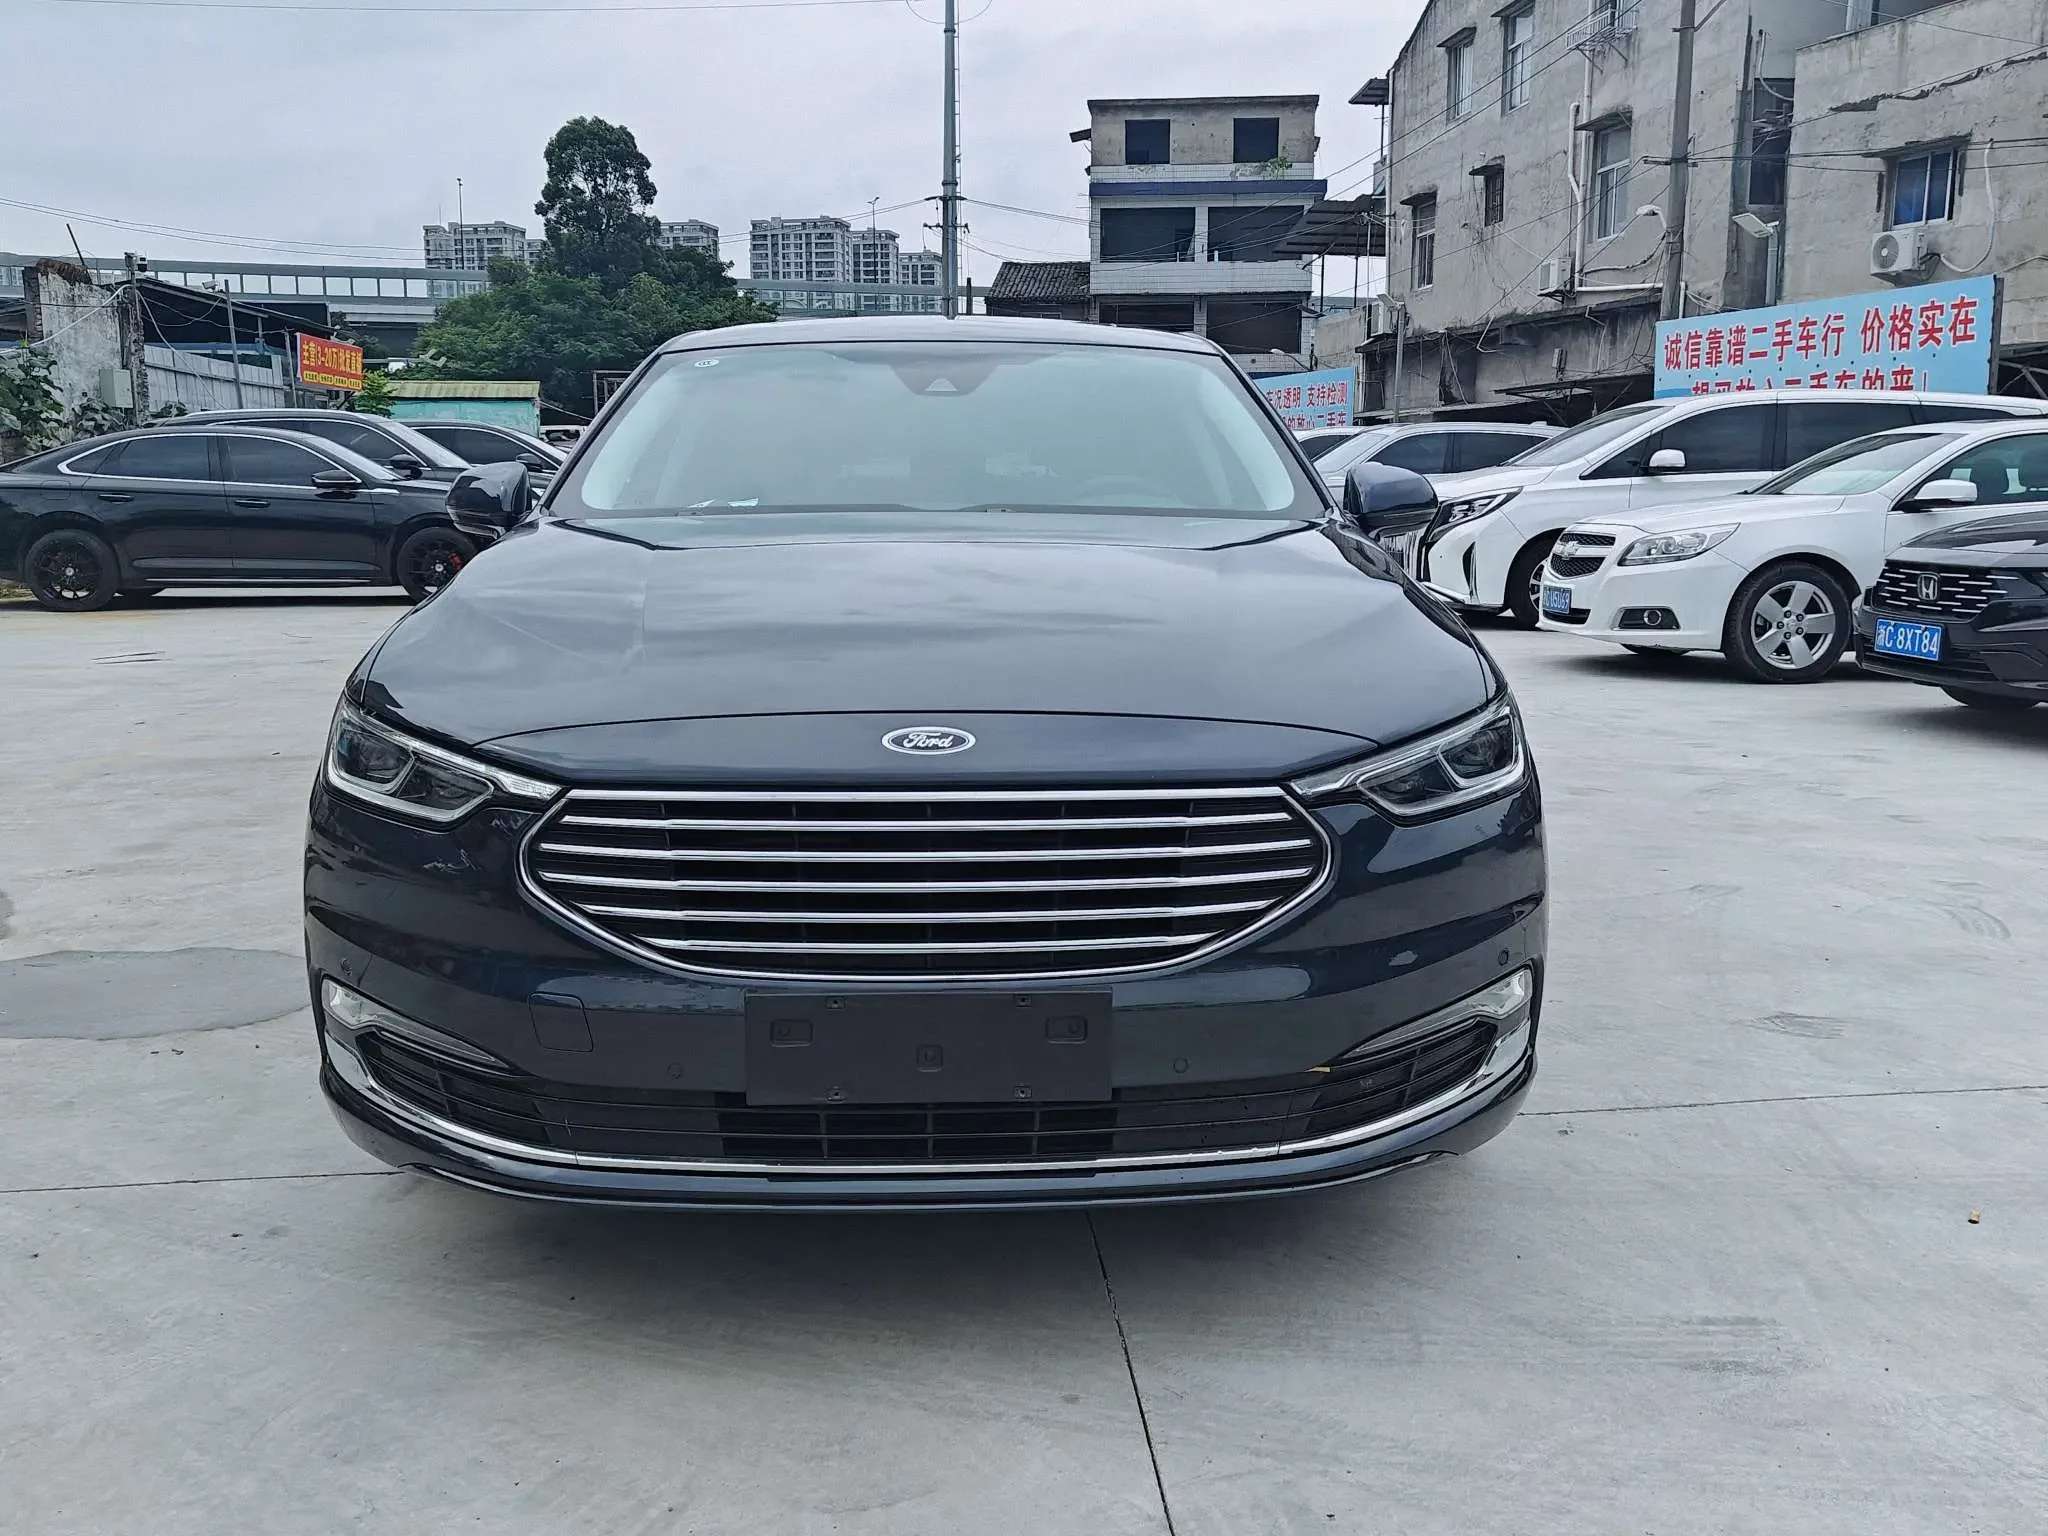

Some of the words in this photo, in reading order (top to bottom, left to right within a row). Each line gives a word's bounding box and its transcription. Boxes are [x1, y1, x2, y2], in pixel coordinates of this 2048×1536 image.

[1664, 313, 1845, 370] 诚信靠谱二手车行
[1860, 295, 1978, 354] 价格实在
[902, 732, 954, 748] Ford
